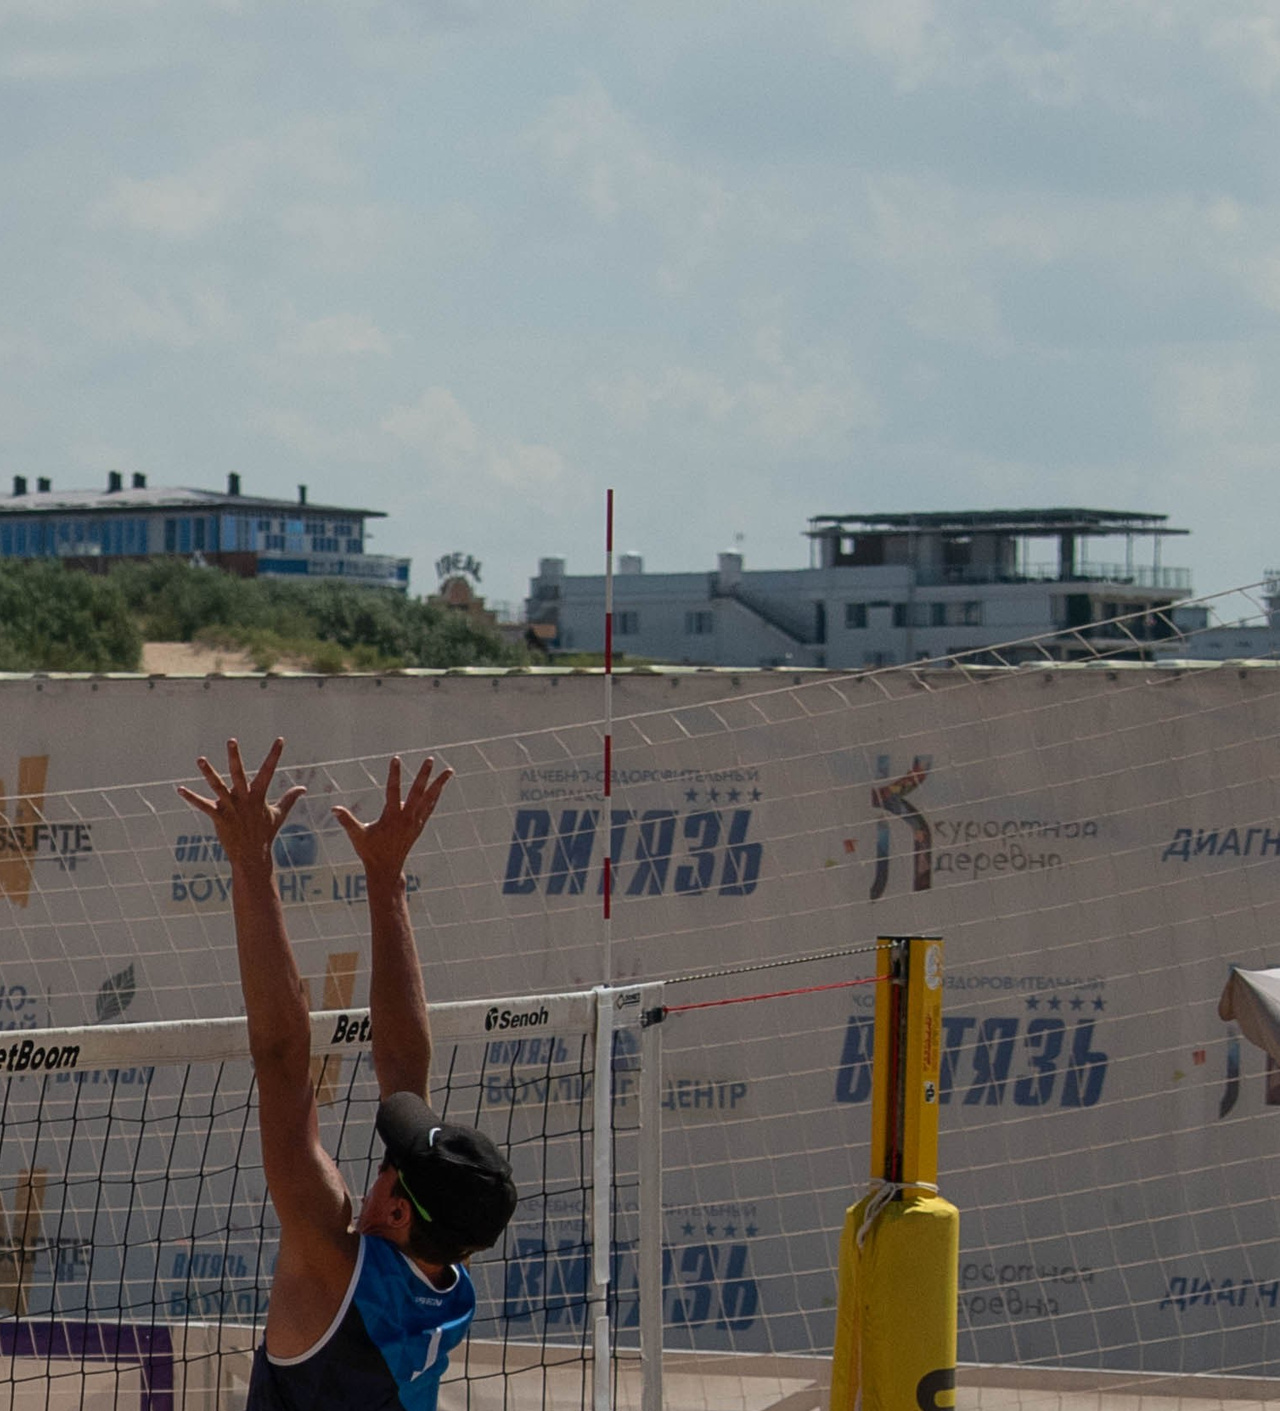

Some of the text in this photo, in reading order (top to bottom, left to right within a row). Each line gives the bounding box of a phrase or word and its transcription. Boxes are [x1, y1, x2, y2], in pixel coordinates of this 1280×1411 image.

[933, 819, 1099, 844] курортная
[502, 809, 764, 896] ВИТЯЗЬ
[499, 1006, 549, 1030] Senoh
